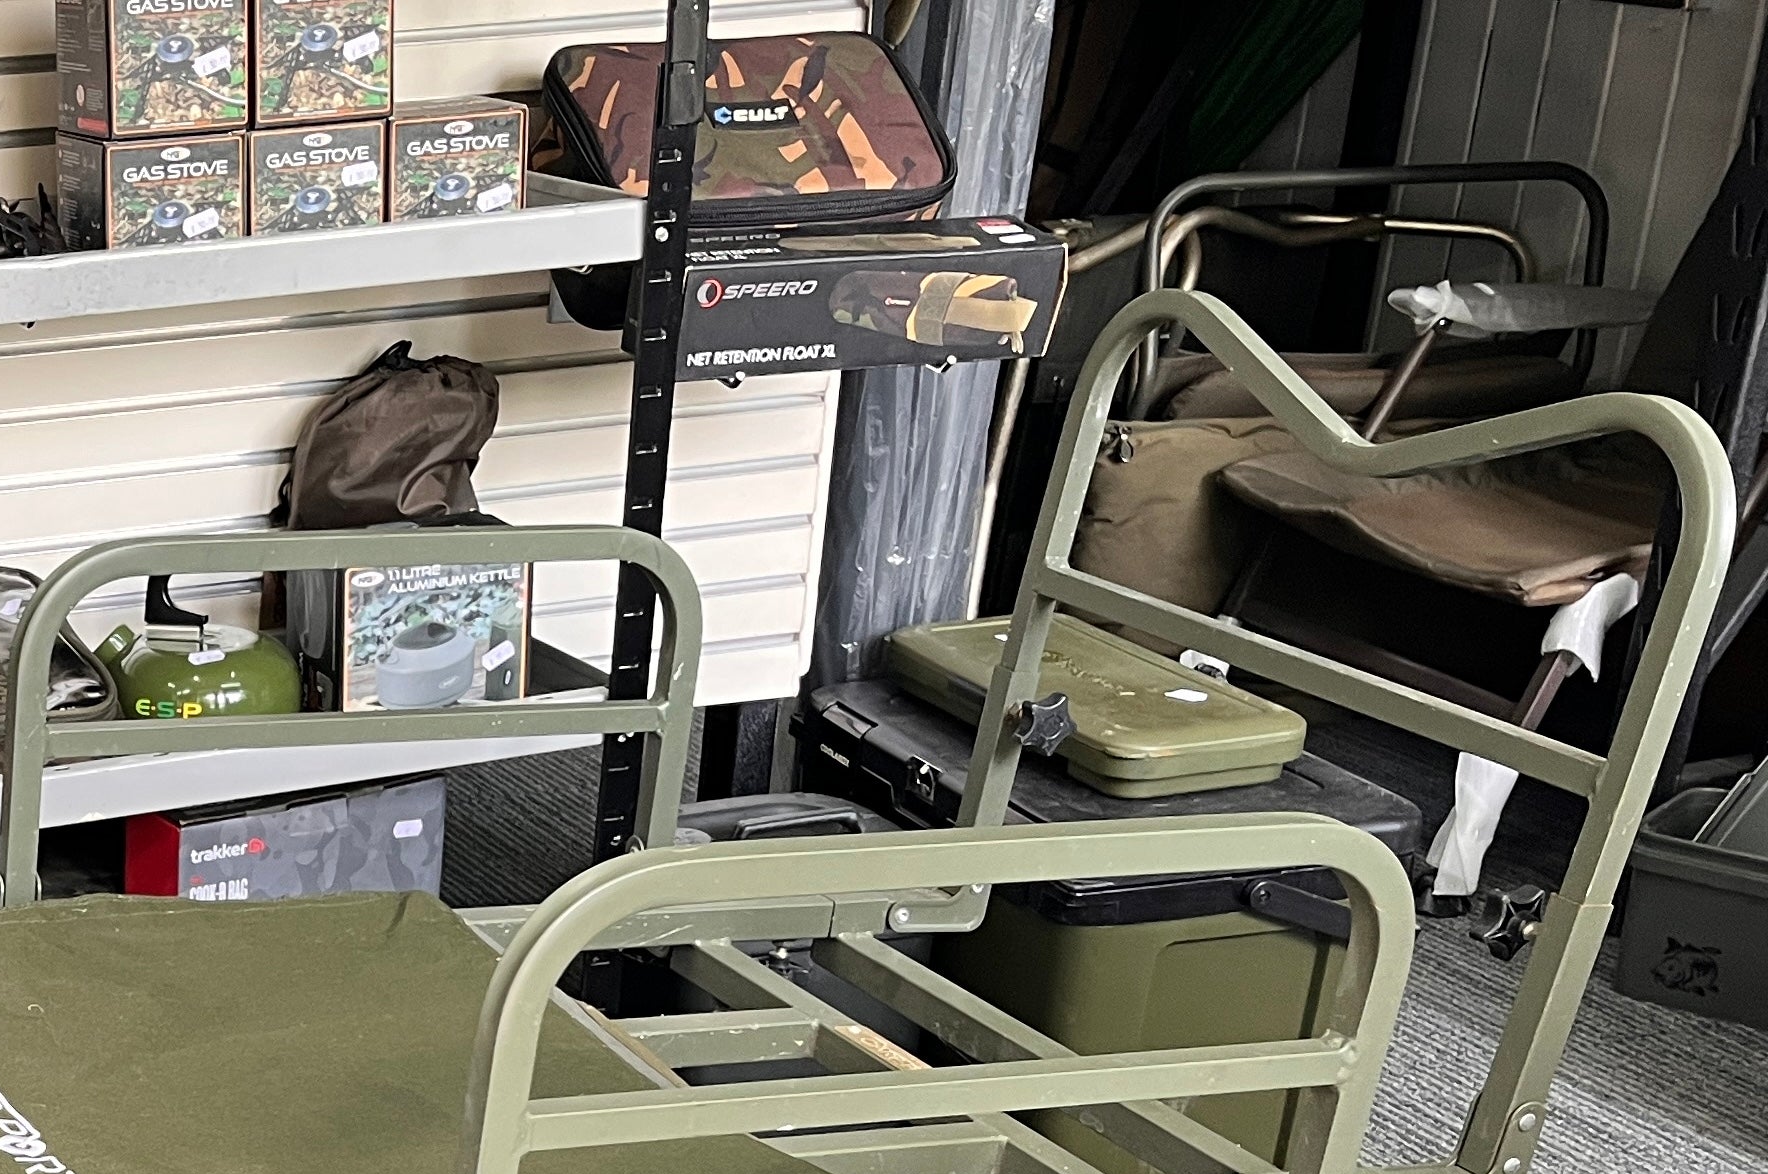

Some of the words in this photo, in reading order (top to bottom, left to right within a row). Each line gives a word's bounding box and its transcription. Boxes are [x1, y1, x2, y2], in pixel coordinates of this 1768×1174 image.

[126, 0, 169, 15] GAS
[733, 106, 789, 122] CULT
[407, 138, 448, 156] GAS
[449, 133, 510, 152] STOVE
[265, 151, 307, 169] GAS
[307, 145, 370, 165] STOVE
[122, 166, 165, 183] GAS
[165, 159, 228, 180] STOVE
[722, 280, 818, 300] SPEERO
[686, 353, 713, 367] NET
[713, 348, 782, 365] RETENTION
[782, 346, 821, 361] FLOAT
[820, 344, 836, 358] XL
[388, 574, 468, 595] ALUMINIUM
[469, 566, 522, 584] KETTLE
[403, 564, 442, 578] LITRE
[189, 843, 249, 865] trakker
